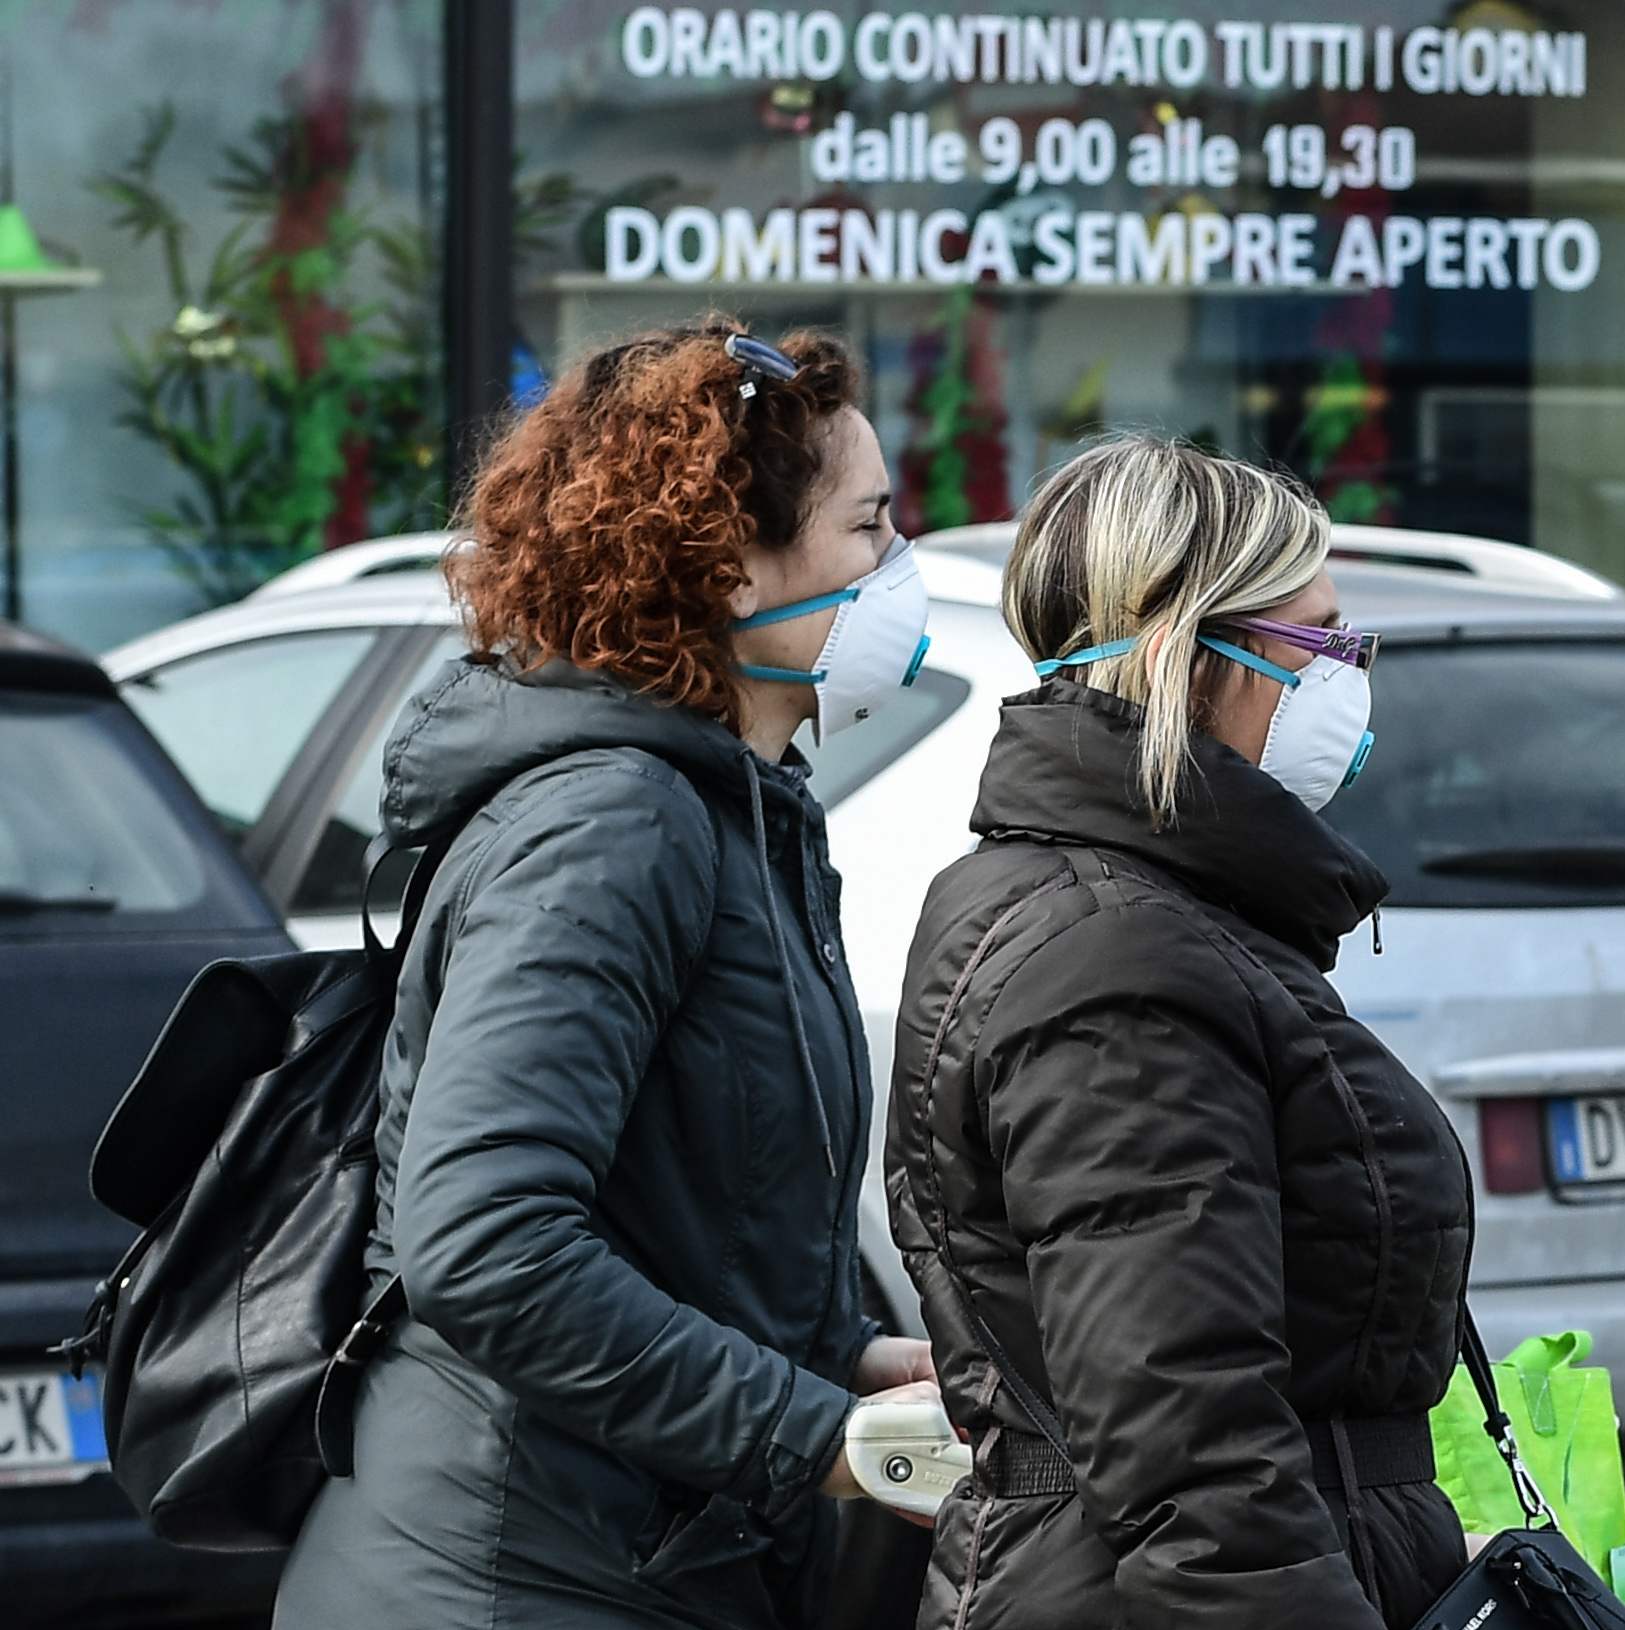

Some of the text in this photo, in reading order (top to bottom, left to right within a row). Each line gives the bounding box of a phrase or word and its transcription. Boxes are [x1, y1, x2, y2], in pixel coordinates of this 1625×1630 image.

[622, 15, 1587, 97] ORARIO CONTINUATO TUTTI I GIORNI
[810, 112, 965, 184] dalle
[977, 118, 1118, 196] 9,00
[1126, 120, 1240, 187] alle
[602, 207, 1601, 292] DOMENICA SEMPRE APERTO
